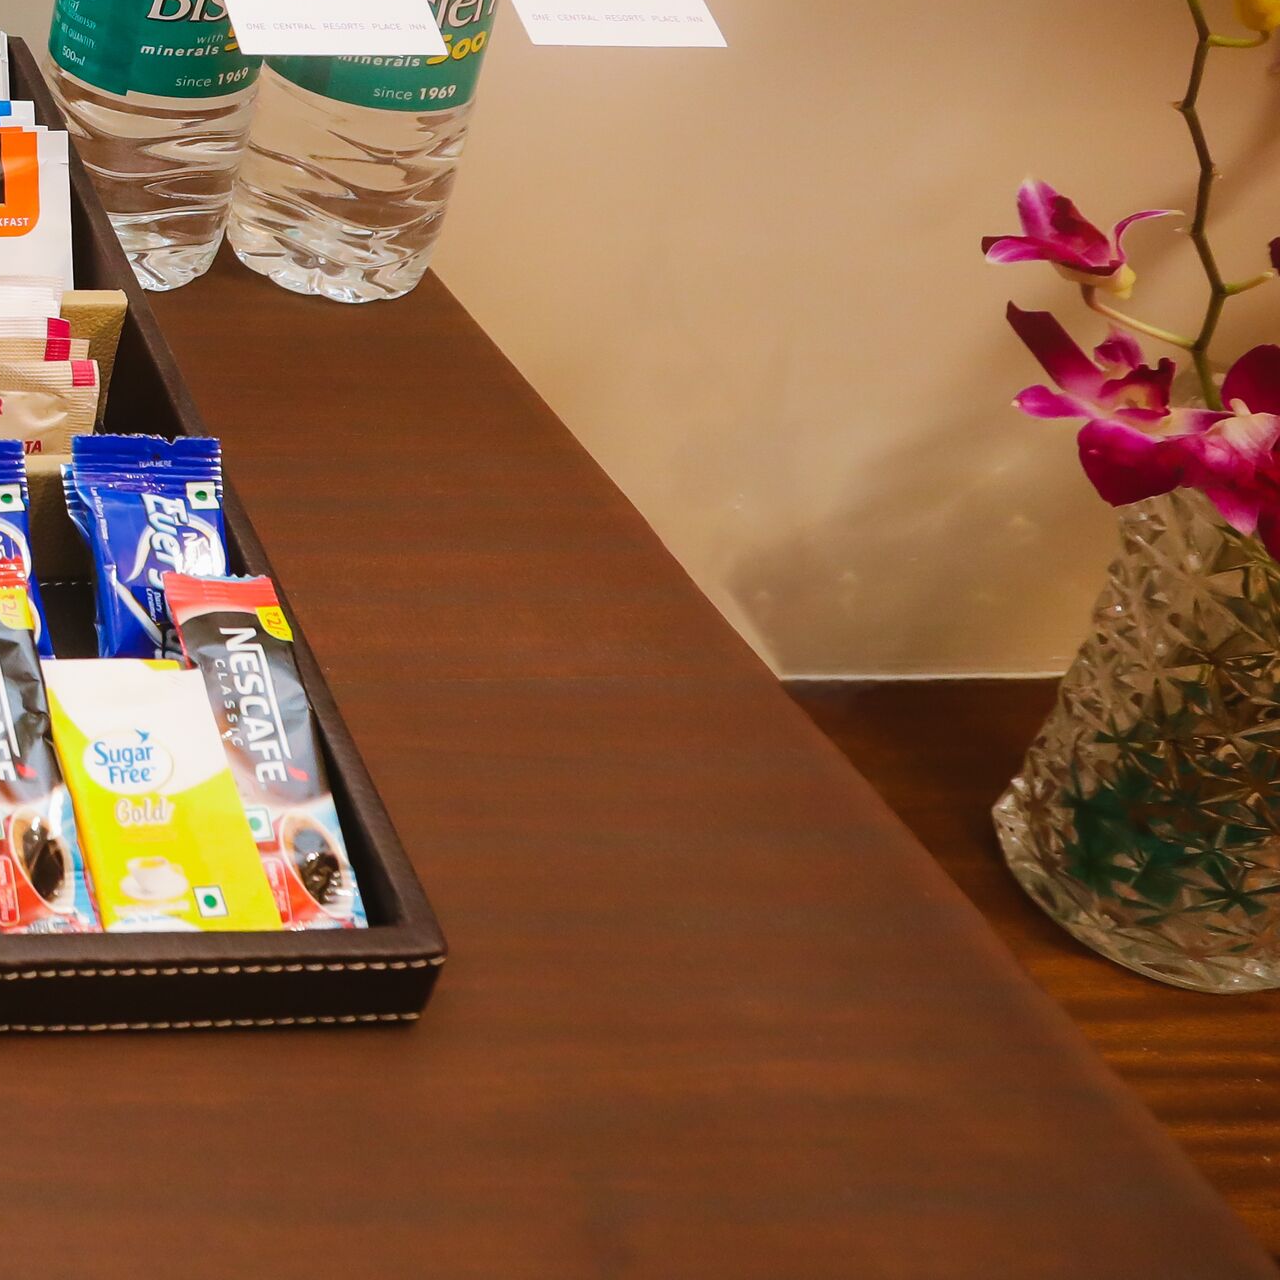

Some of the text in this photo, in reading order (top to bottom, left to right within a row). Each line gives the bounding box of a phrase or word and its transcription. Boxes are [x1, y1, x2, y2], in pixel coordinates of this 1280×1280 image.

[246, 23, 265, 31] ONE
[273, 23, 316, 31] CENTRAL
[324, 23, 366, 31] RESORTS
[372, 23, 403, 31] PLACE
[197, 34, 223, 44] with
[62, 45, 86, 66] 500ml
[140, 44, 219, 56] minerals
[176, 67, 249, 87] since 1969
[373, 85, 456, 100] since 1969
[215, 659, 244, 746] CLASSIC
[93, 741, 154, 767] Sugar
[108, 766, 152, 784] Free
[115, 797, 168, 826] Gold
